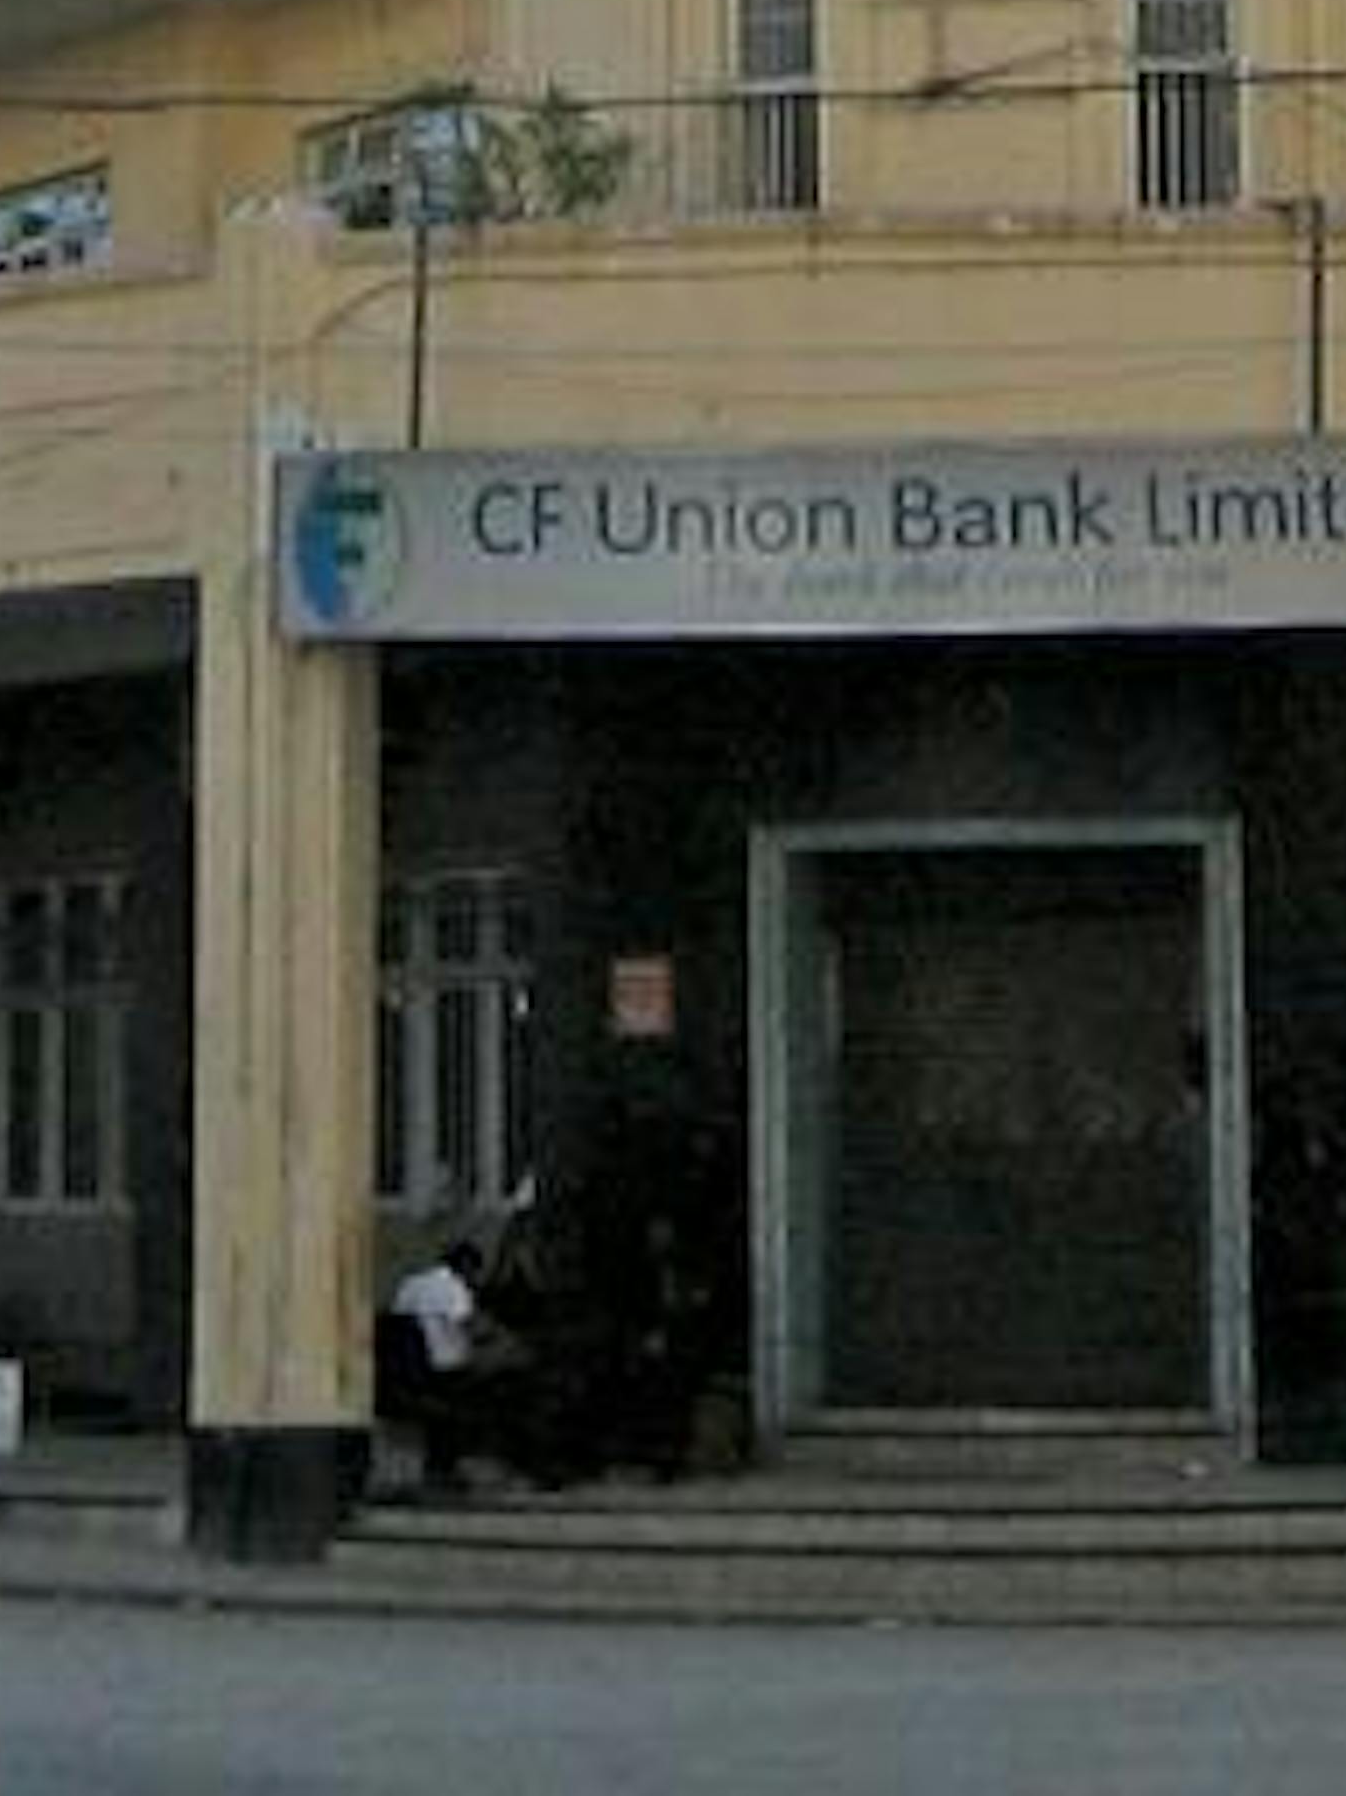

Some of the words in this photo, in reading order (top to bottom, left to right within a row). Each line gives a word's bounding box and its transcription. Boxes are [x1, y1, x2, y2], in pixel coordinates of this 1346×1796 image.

[470, 479, 562, 556] CF
[593, 477, 856, 556] Union
[890, 467, 1116, 552] Bank
